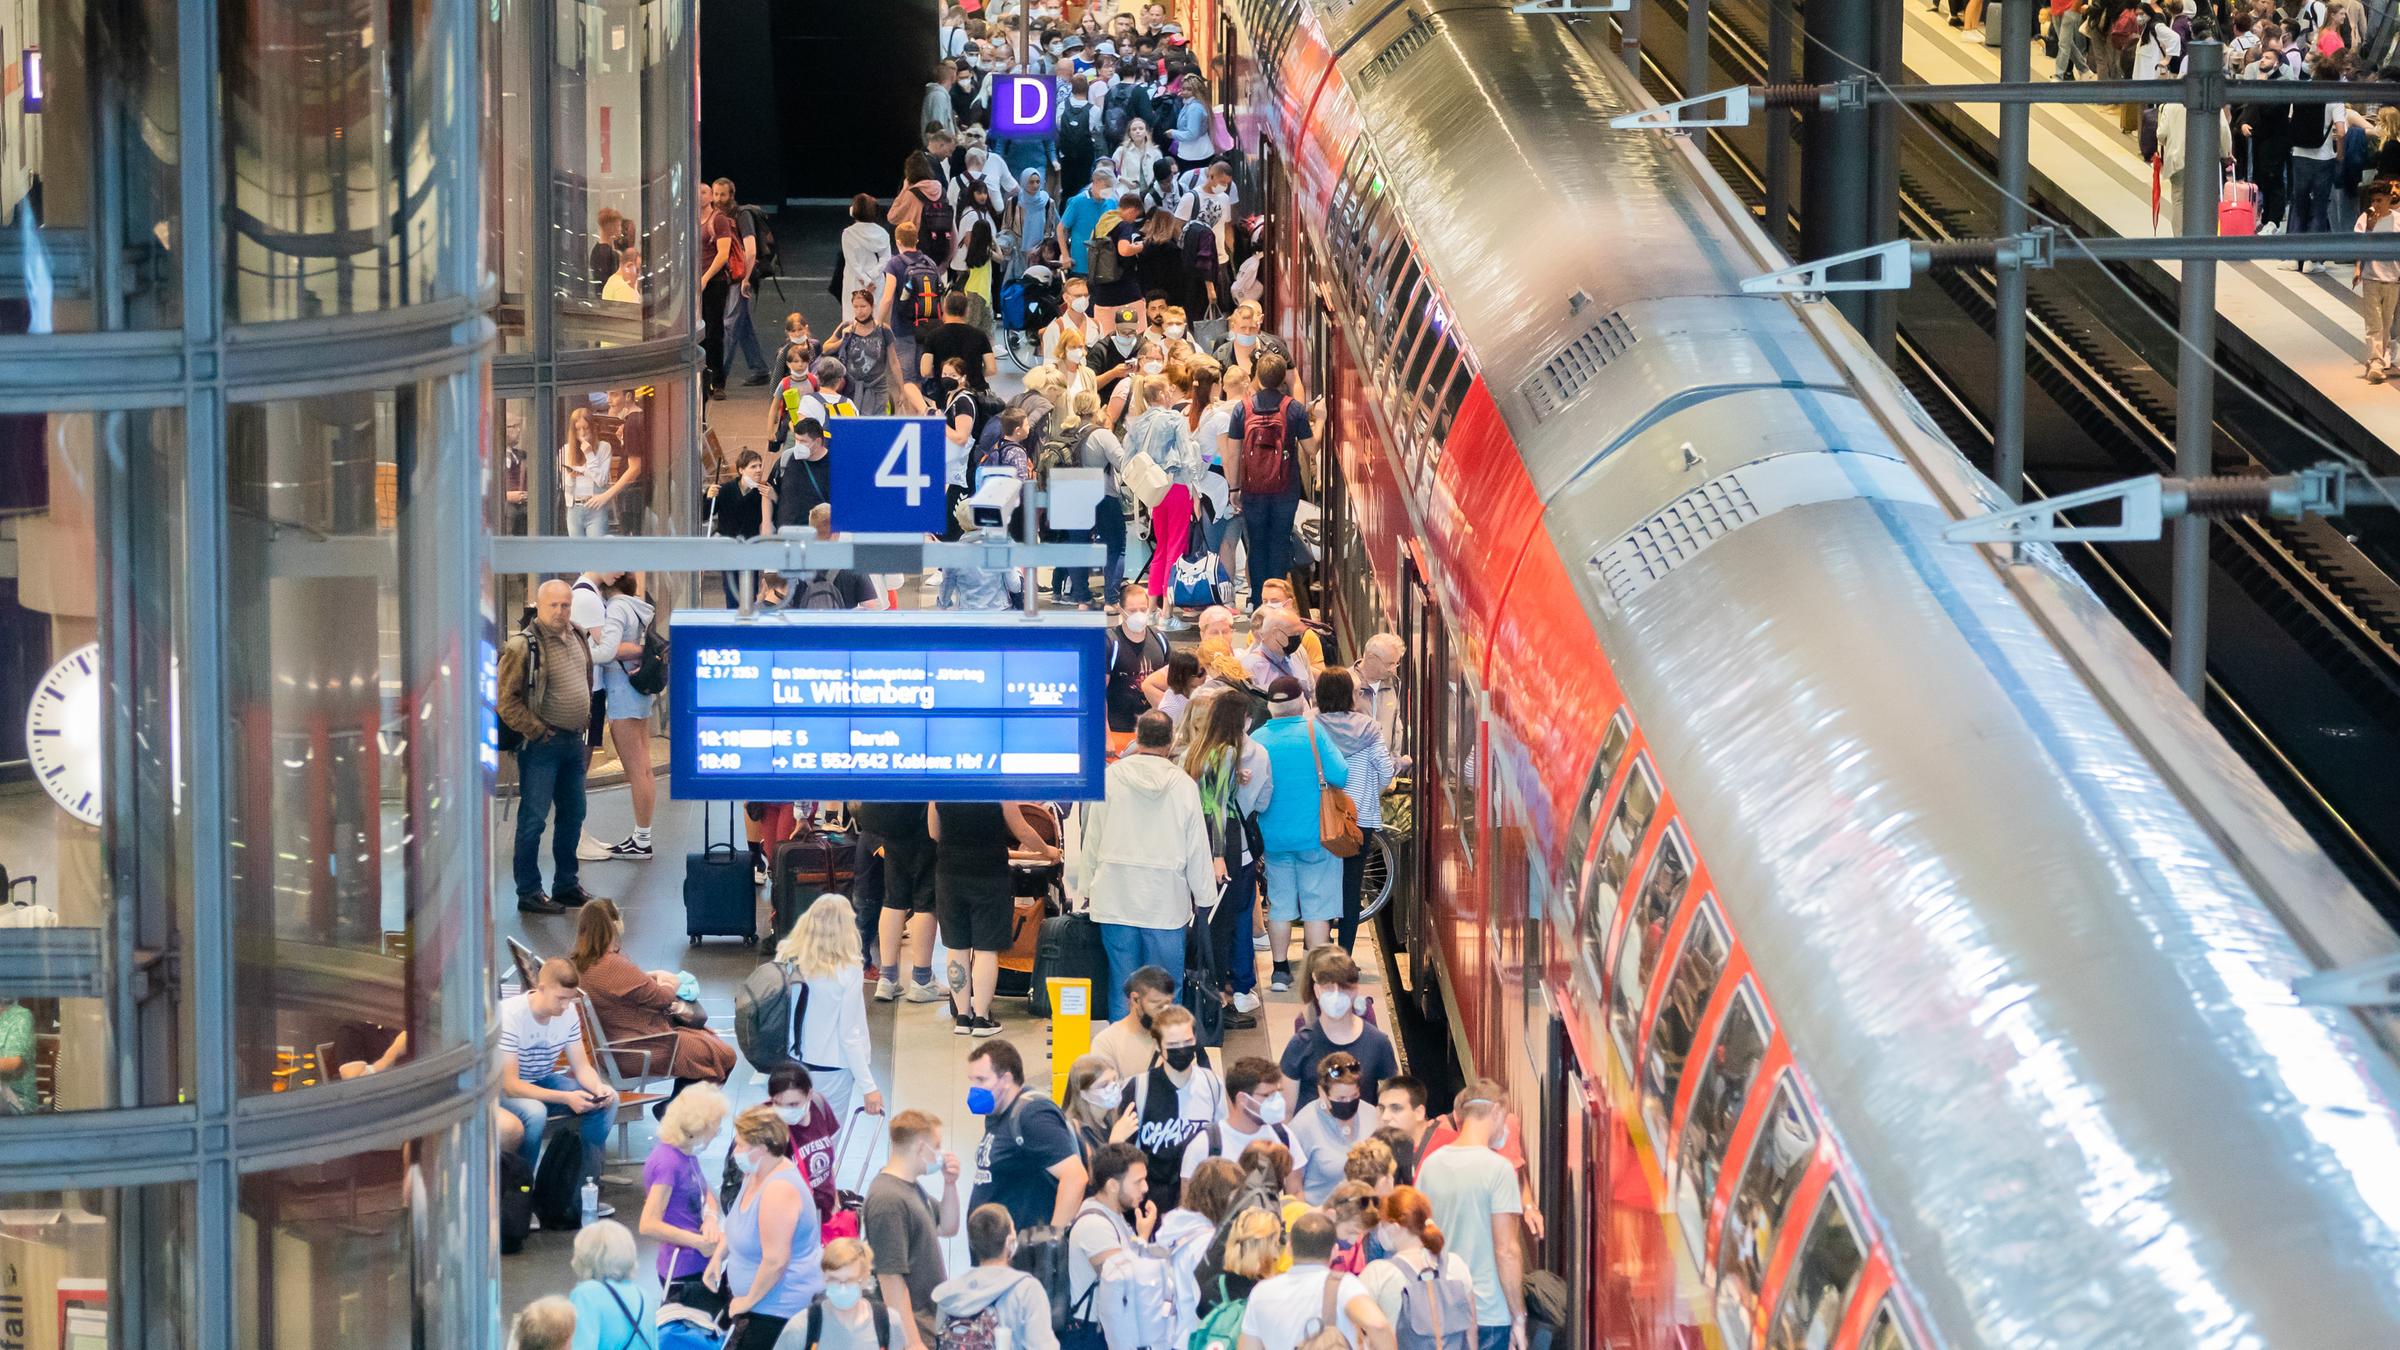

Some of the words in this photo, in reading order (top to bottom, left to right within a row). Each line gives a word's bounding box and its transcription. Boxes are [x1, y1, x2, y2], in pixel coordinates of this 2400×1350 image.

[1013, 78, 1048, 124] D
[875, 423, 931, 506] 4
[810, 682, 935, 709] Wittenberg
[792, 753, 817, 769] ICE
[892, 753, 952, 769] Koblenz
[956, 753, 984, 769] Hbf
